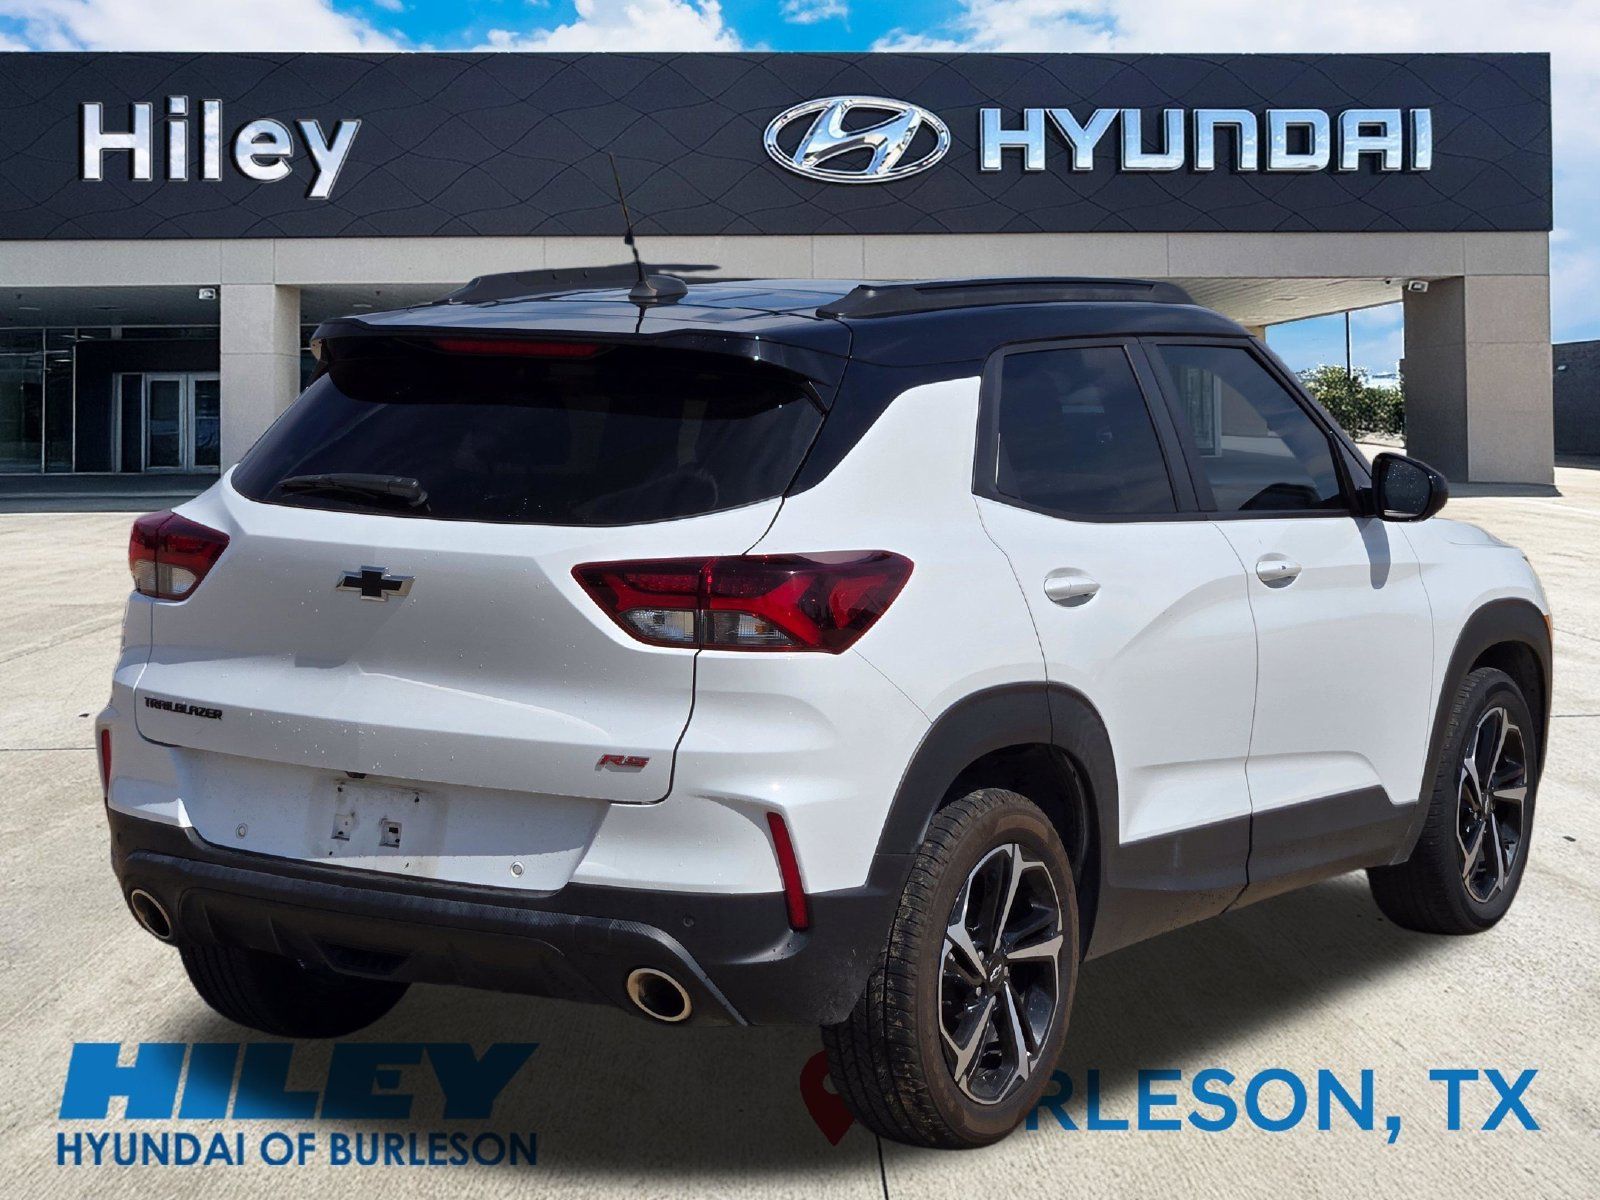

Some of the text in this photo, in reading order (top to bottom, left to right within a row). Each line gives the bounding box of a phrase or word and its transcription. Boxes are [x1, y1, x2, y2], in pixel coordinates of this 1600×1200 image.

[80, 95, 361, 199] Hiley
[980, 107, 1433, 172] HYUNDAI
[144, 696, 223, 720] TRAILBLAZER
[597, 754, 650, 770] RS
